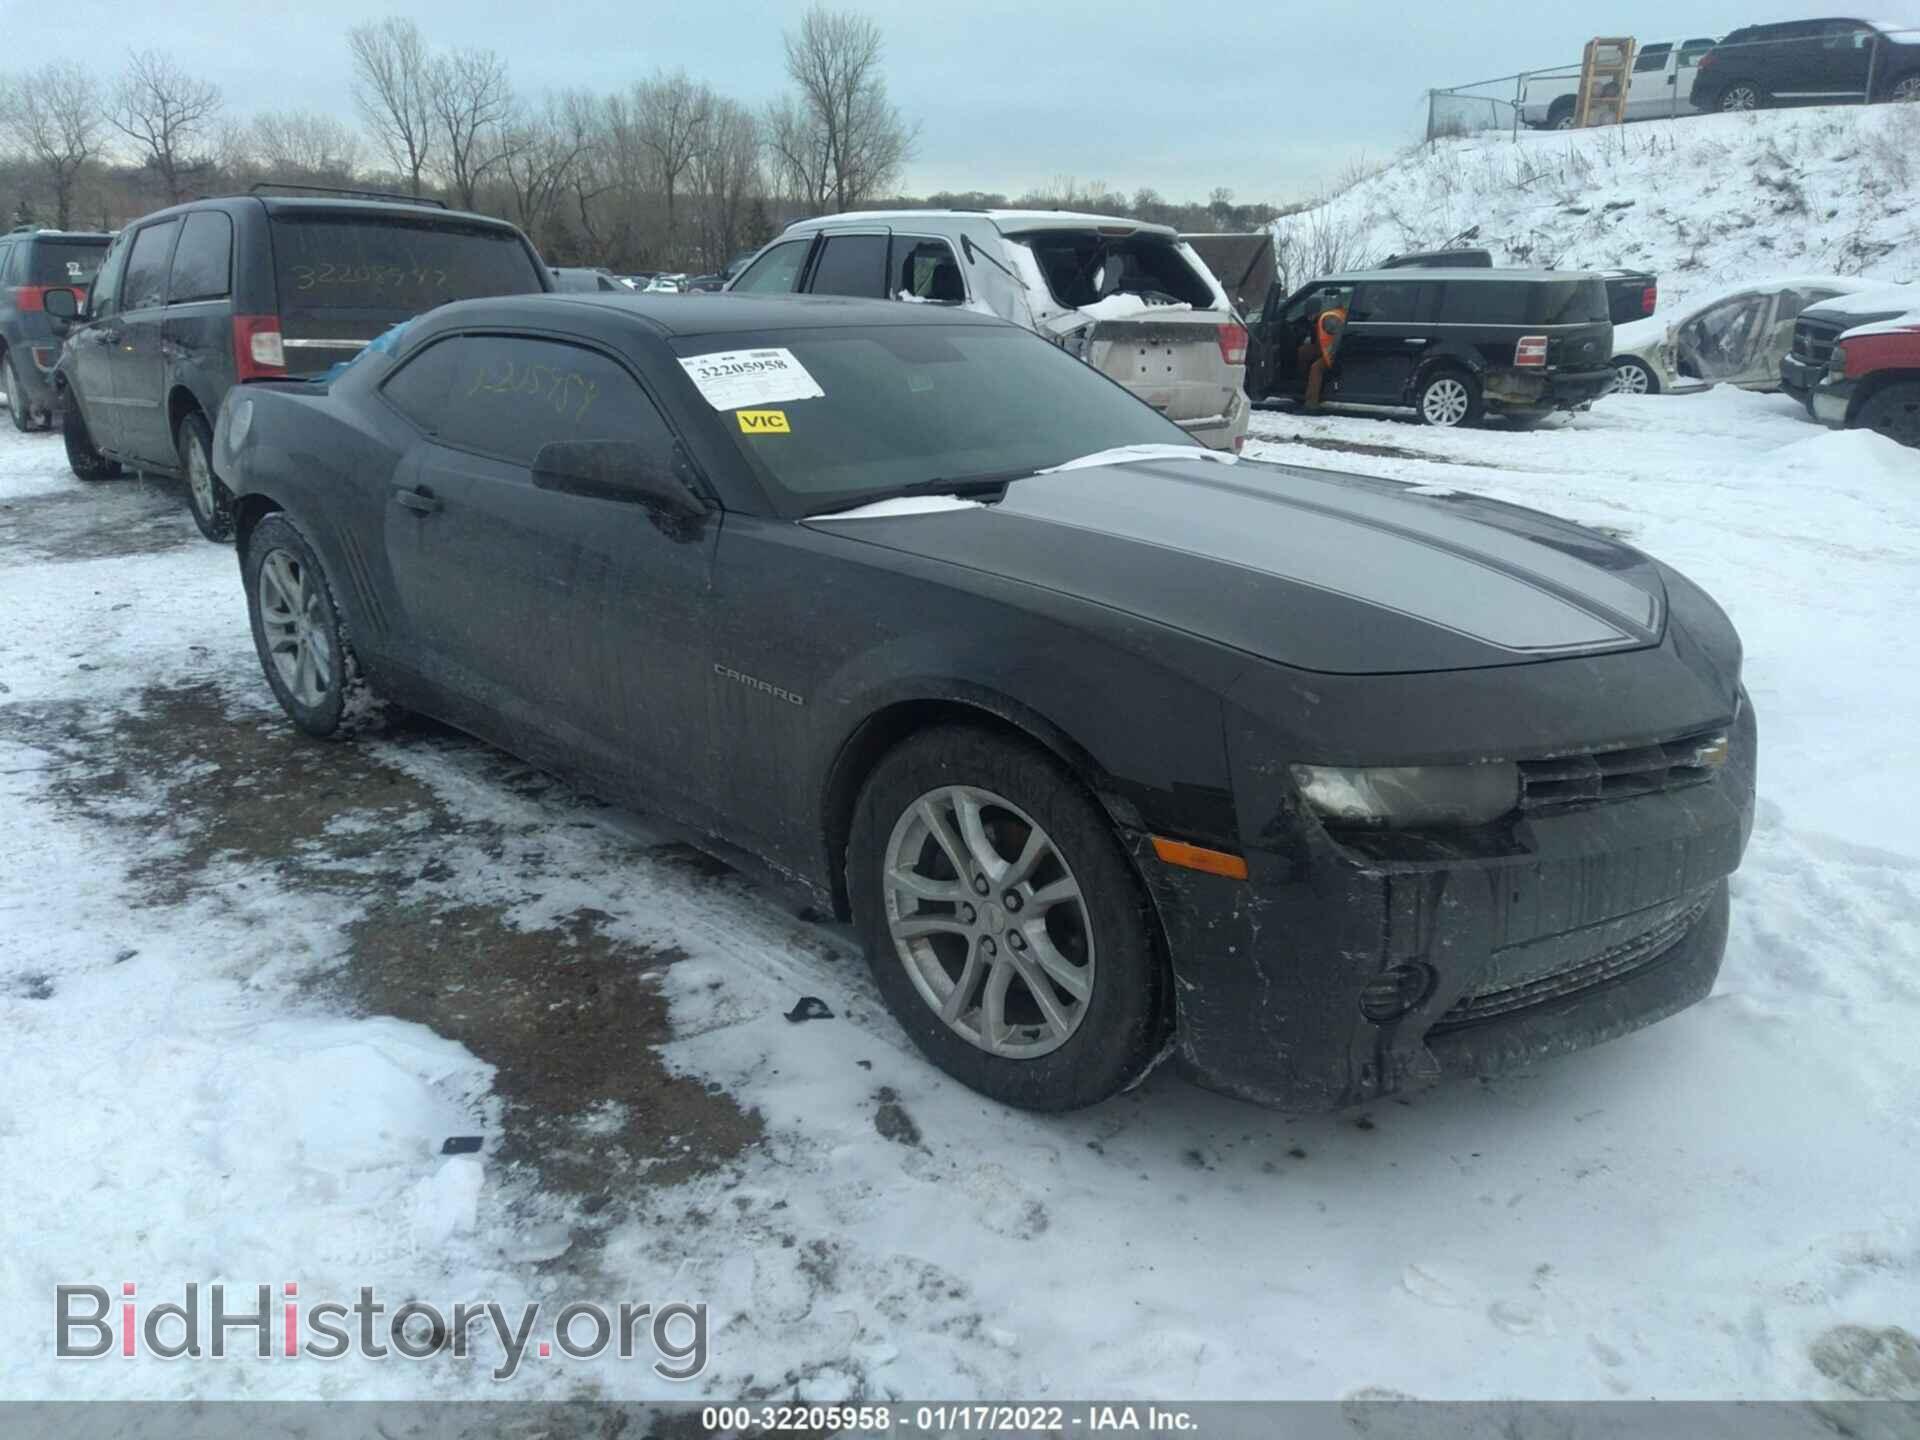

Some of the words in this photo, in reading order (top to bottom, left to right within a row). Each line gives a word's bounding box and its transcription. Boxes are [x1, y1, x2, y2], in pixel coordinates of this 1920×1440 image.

[697, 359, 788, 379] 32205958
[742, 415, 784, 427] VIC
[713, 663, 804, 705] CAMARO
